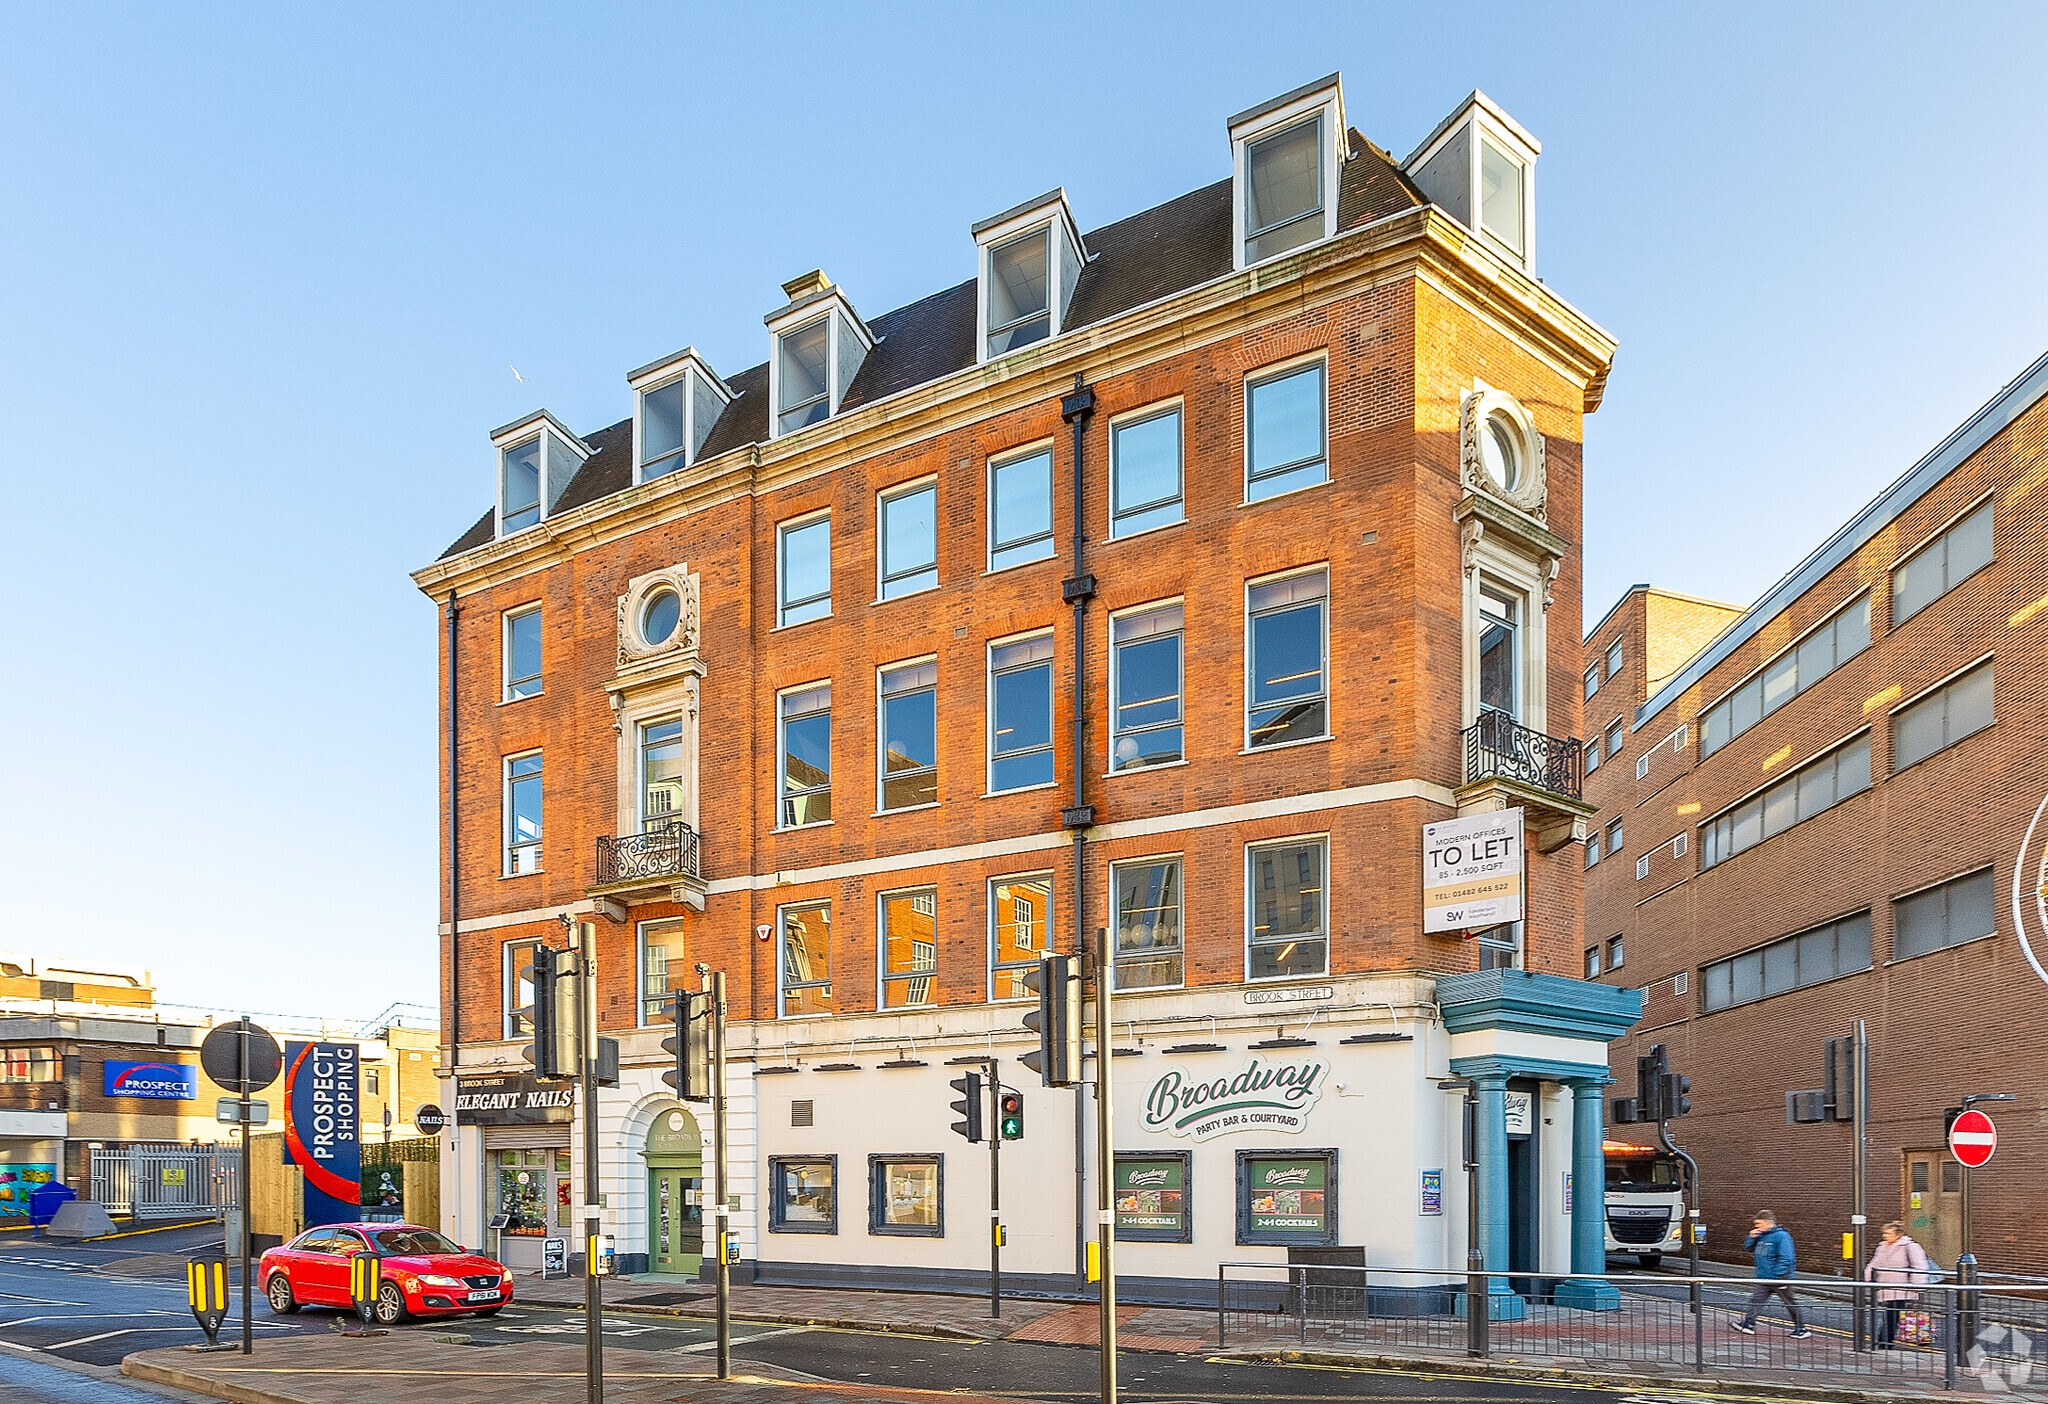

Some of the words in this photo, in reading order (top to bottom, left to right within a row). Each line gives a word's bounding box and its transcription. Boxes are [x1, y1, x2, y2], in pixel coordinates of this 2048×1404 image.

[1436, 834, 1471, 846] MODERN
[1472, 827, 1507, 840] OFFICES
[1429, 846, 1462, 868] TO
[1471, 836, 1514, 861] LET
[1438, 871, 1449, 879] 85
[1456, 866, 1479, 877] 2,500
[1481, 862, 1504, 873] SQFT
[1452, 888, 1476, 898] 01482
[1477, 885, 1493, 894] 645
[1494, 883, 1509, 891] 522
[1249, 992, 1283, 1002] BROOK
[1289, 988, 1327, 1000] STREET
[125, 1079, 189, 1092] PROSPECT
[464, 1079, 482, 1087] BROOK
[483, 1078, 505, 1086] STREET
[337, 1048, 353, 1140] SHOPPING
[455, 1092, 521, 1110] ELEGANT
[525, 1089, 573, 1109] NAILS
[1146, 1060, 1321, 1125] Broadway
[313, 1047, 334, 1158] PROSPECT
[418, 1115, 443, 1124] NAILS
[1195, 1119, 1221, 1136] PARTY
[1222, 1115, 1239, 1127] BAR
[1241, 1114, 1248, 1124] &
[1250, 1113, 1299, 1126] COURTYARD
[1128, 1168, 1169, 1185] Broadway
[1265, 1167, 1310, 1184] Broadway
[1138, 1217, 1177, 1225] COCKTAILS
[1275, 1219, 1318, 1227] COCKTAILS
